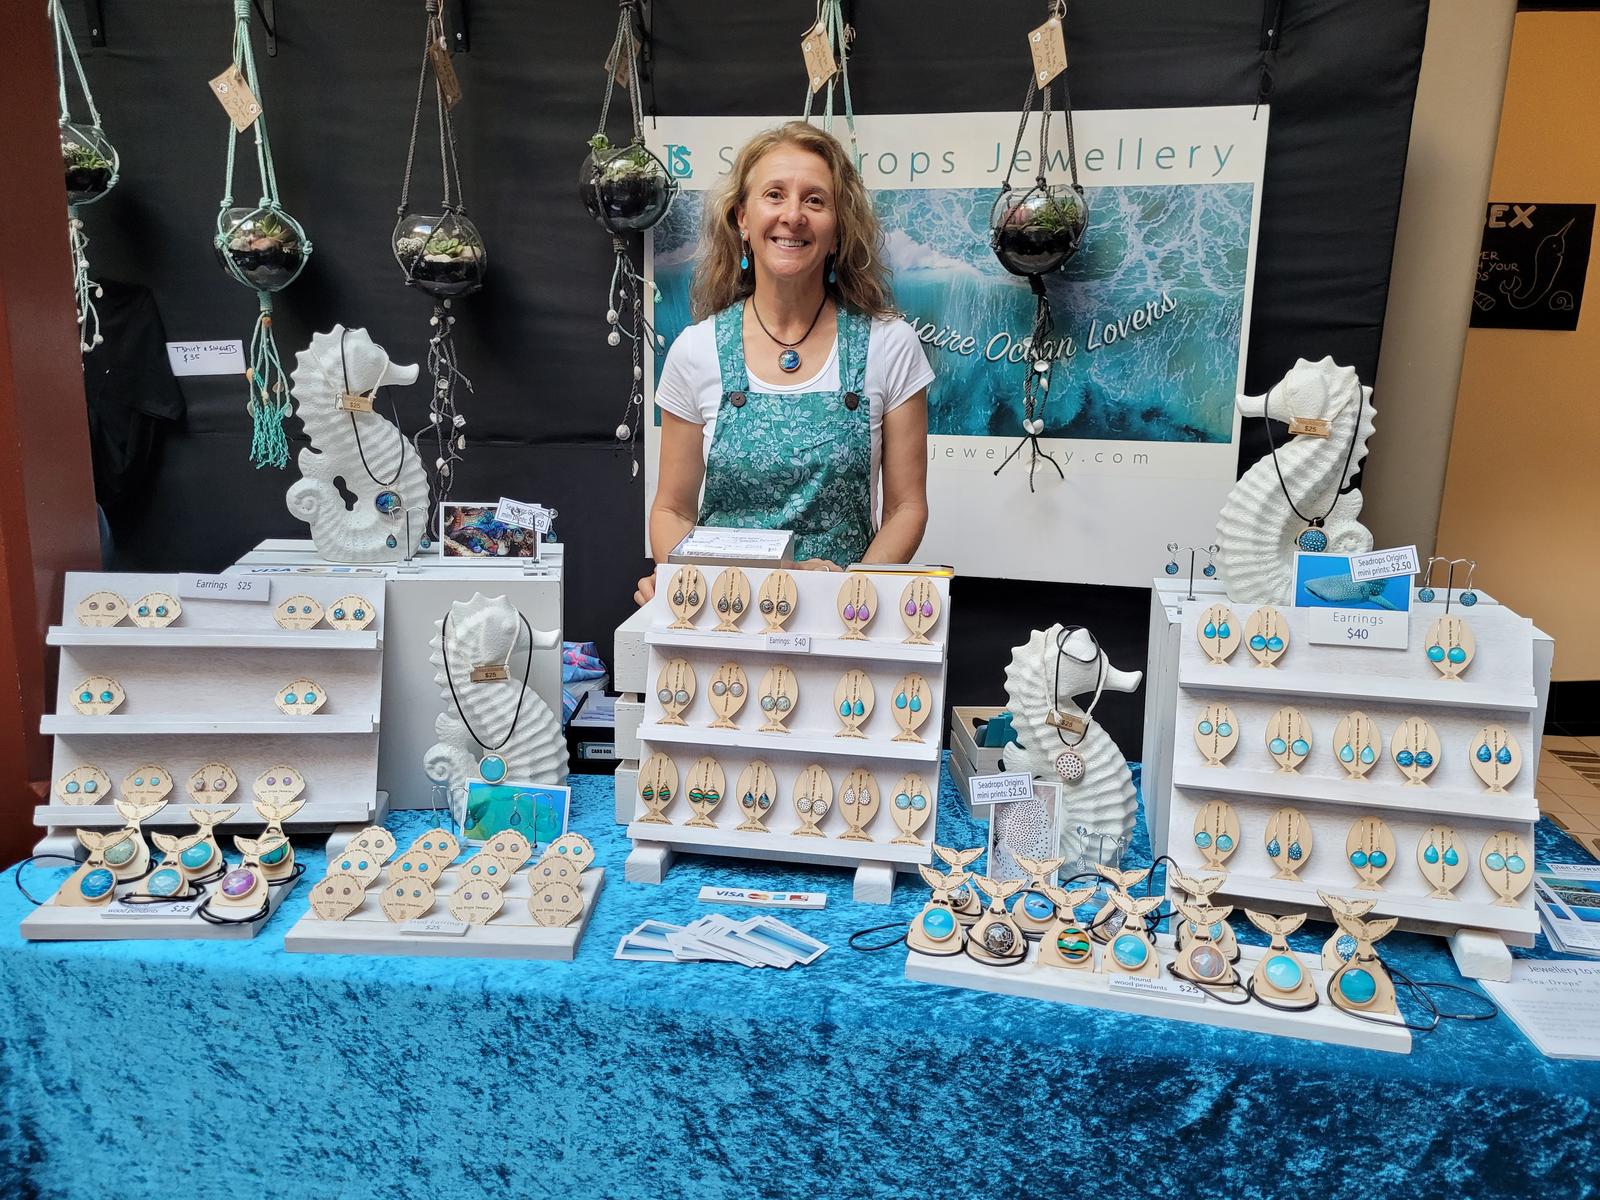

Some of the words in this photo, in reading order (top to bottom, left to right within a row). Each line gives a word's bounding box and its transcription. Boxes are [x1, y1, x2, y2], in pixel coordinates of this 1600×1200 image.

[986, 138, 1234, 177] Jewellery
[1489, 262, 1519, 273] YOUR
[1086, 289, 1178, 351] Lovers
[1358, 557, 1386, 567] Seadrops
[1386, 553, 1408, 564] Origins
[1358, 569, 1371, 577] mini
[1391, 560, 1412, 572] $2.50
[196, 579, 228, 591] Earrings
[237, 580, 252, 591] $25
[1333, 612, 1384, 626] Earrings
[1347, 627, 1369, 640] $40
[794, 636, 807, 647] $40
[977, 780, 1004, 789] Seadrops
[1004, 778, 1025, 788] Origins
[1008, 786, 1028, 798] $2.50
[716, 890, 745, 898] VISA
[170, 905, 192, 913] $25
[1527, 965, 1579, 976] Jewellery
[1579, 967, 1592, 975] to
[1135, 982, 1168, 991] pendants
[1179, 984, 1199, 994] $25
